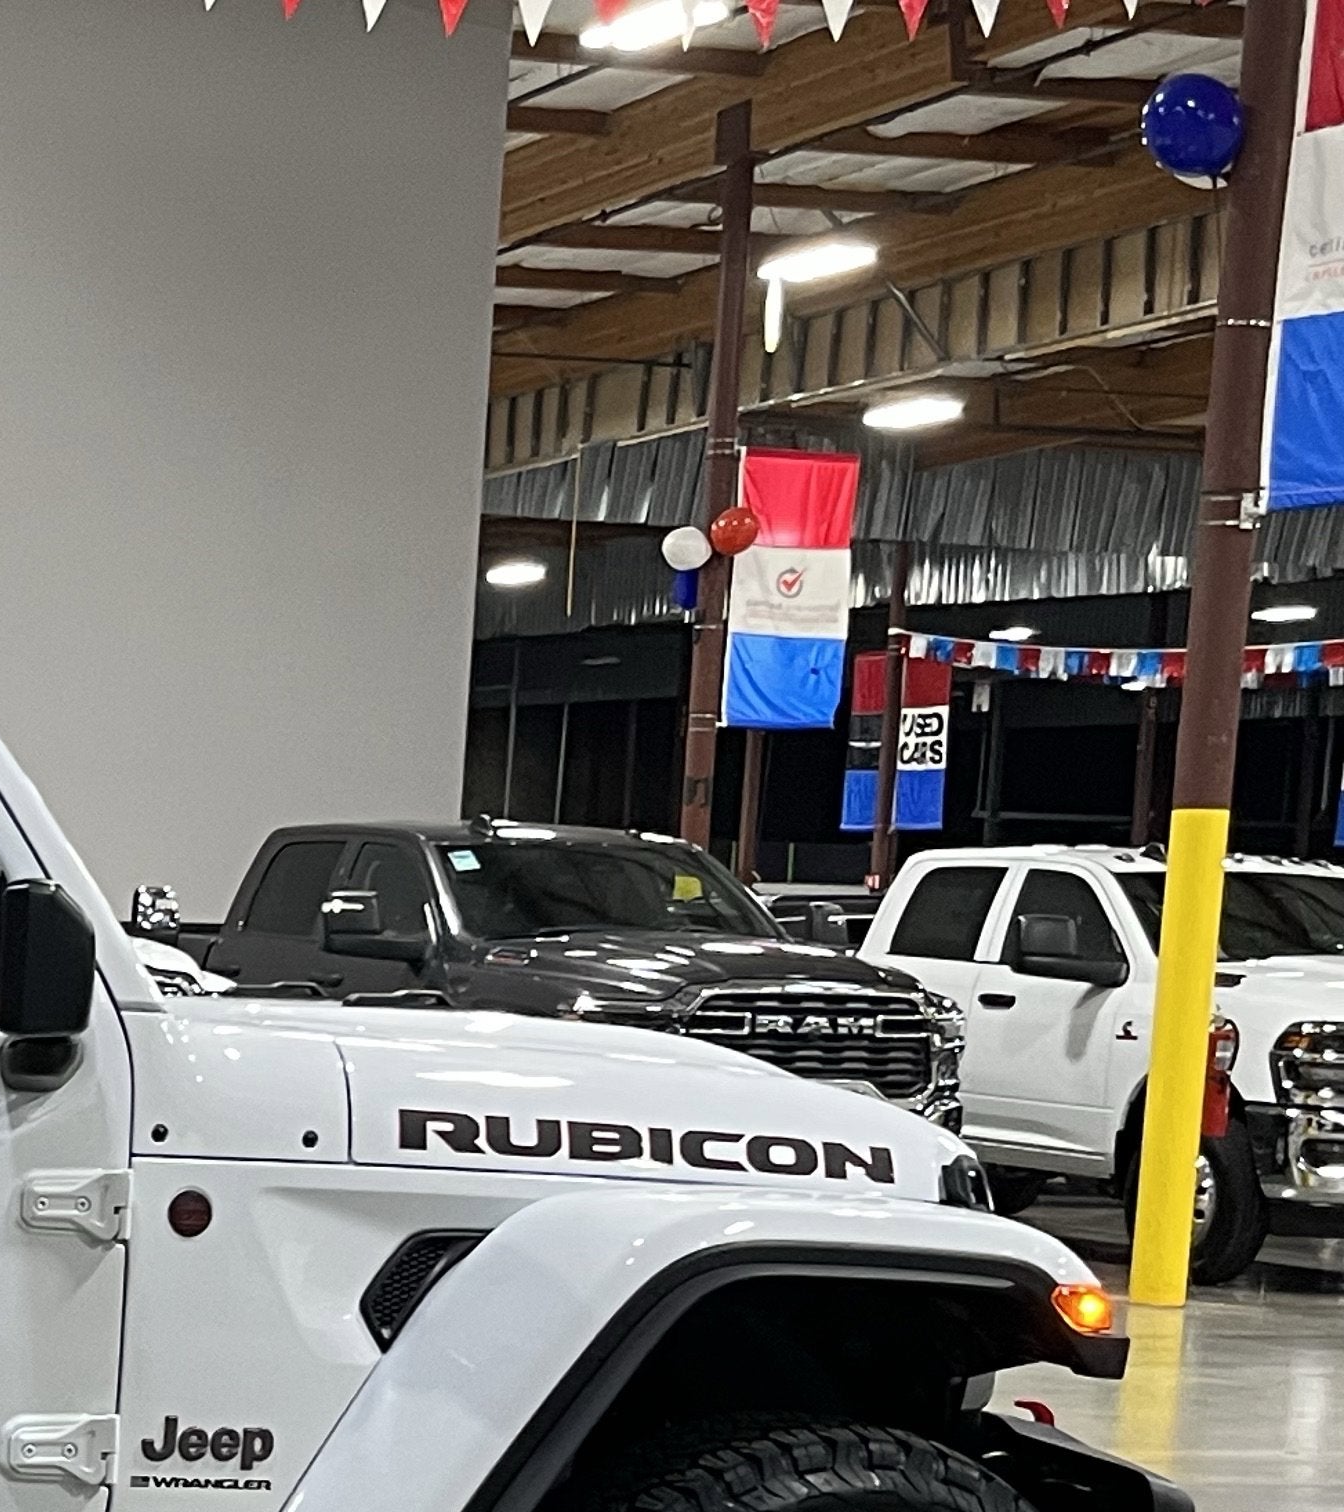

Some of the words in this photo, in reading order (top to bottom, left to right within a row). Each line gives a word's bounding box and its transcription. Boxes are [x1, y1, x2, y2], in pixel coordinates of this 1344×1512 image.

[755, 1014, 874, 1035] RAM
[398, 1108, 896, 1184] RUBICON
[140, 1415, 275, 1471] Jeep
[152, 1475, 272, 1491] WRANGLER
